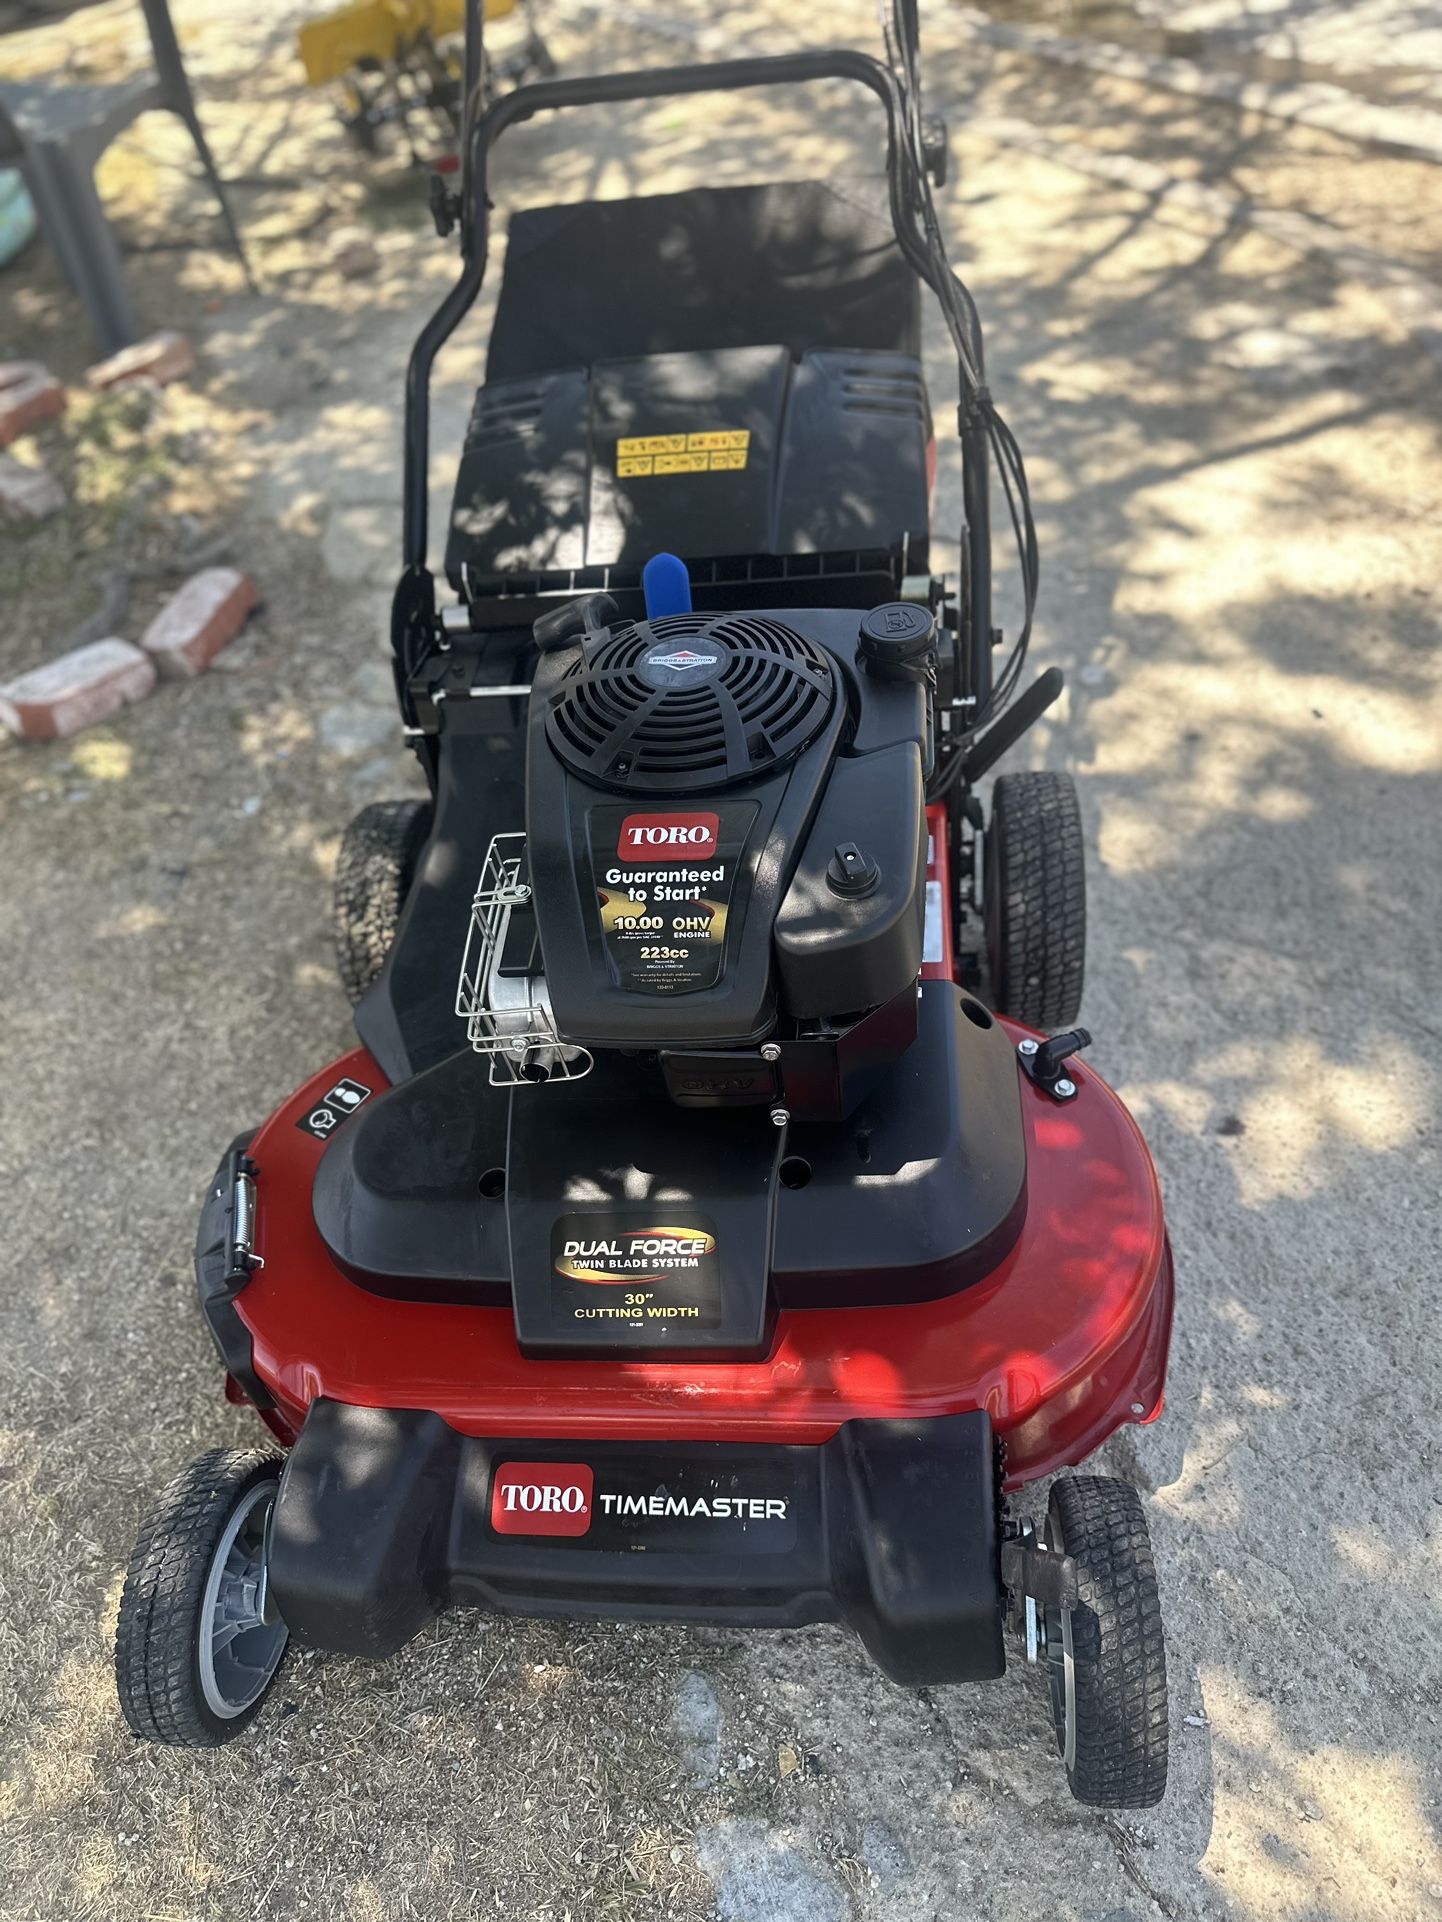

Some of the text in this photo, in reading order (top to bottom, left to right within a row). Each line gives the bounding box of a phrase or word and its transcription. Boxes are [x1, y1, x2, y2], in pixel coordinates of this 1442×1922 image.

[606, 866, 724, 883] Guaranteed
[628, 887, 647, 902] to
[614, 916, 710, 930] 10.00 OHV
[640, 946, 689, 959] 223cc
[564, 1238, 707, 1257] DUAL FORCE
[572, 1257, 699, 1269] TWIN BLADE SYSTEM
[624, 1293, 654, 1305] 30"
[574, 1307, 699, 1318] CUTTING WIDTH
[600, 1494, 787, 1520] TIMEMASTER
